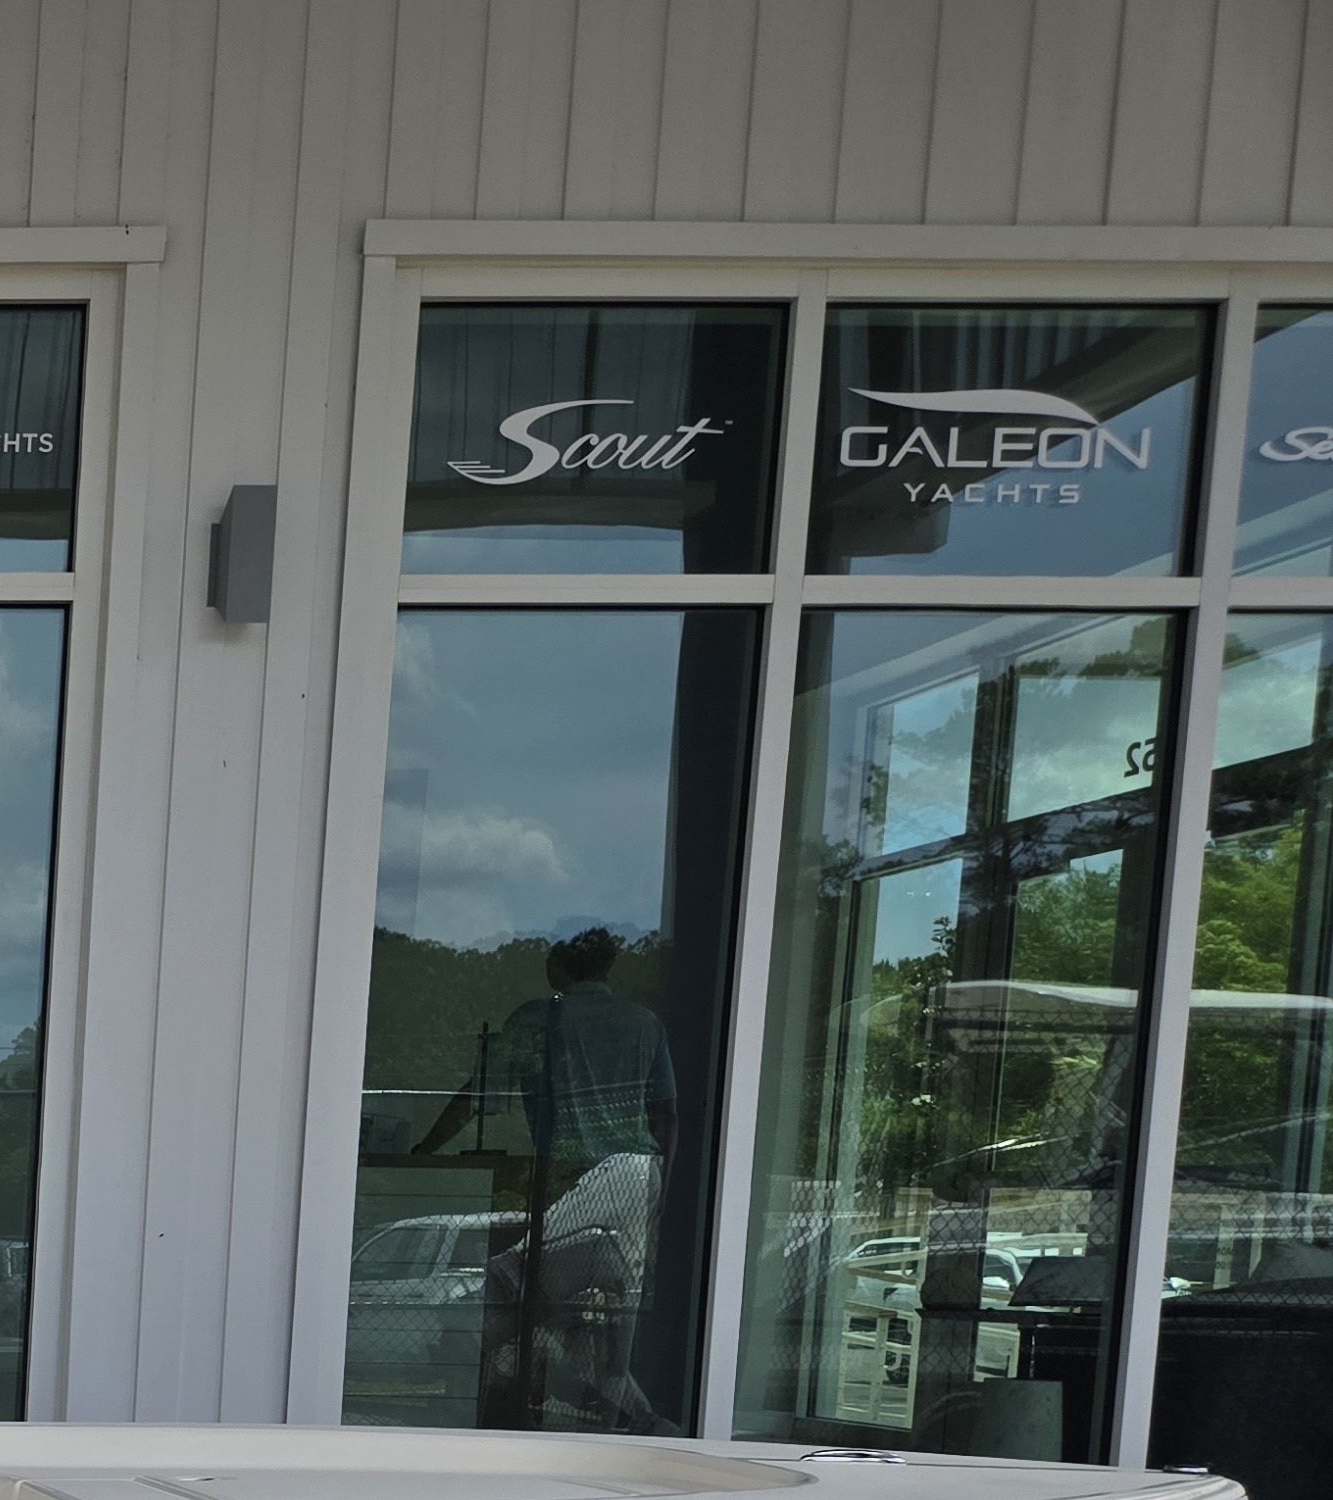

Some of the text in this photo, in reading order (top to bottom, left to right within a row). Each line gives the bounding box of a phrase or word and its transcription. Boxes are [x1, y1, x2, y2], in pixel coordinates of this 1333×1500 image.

[447, 399, 724, 485] Scout
[840, 426, 1151, 469] GALEON
[904, 483, 1081, 503] YACHTS
